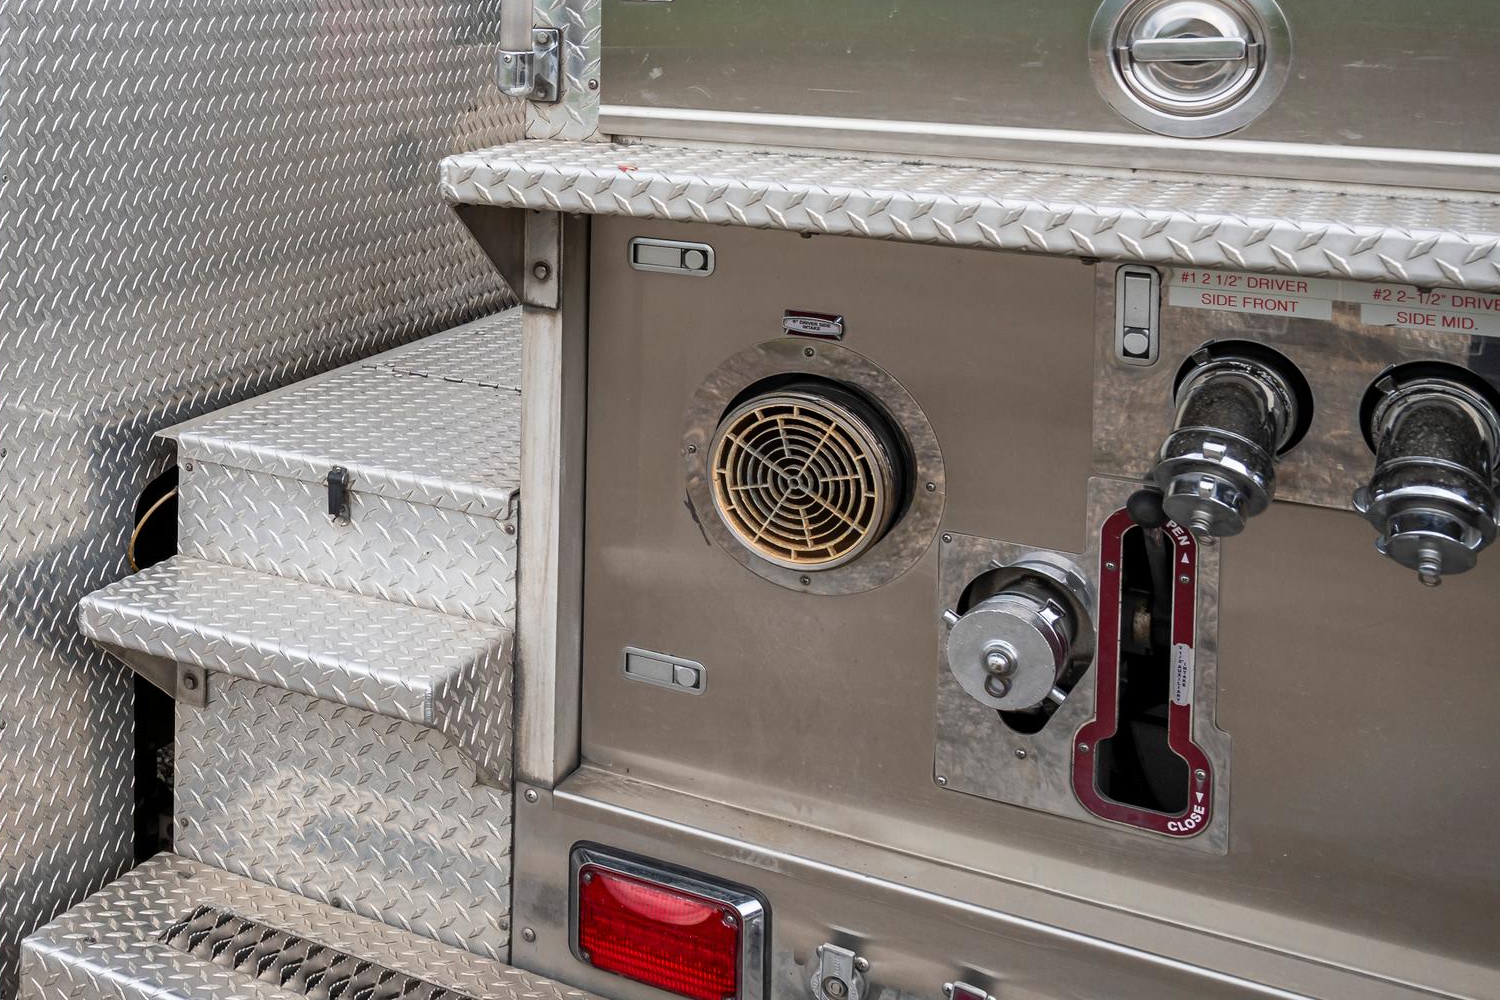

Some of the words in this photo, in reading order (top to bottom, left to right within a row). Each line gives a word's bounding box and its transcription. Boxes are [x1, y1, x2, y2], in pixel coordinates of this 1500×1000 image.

[1181, 271, 1196, 283] #1
[1202, 273, 1211, 285] 2
[1216, 274, 1243, 287] 1/2"
[1247, 277, 1308, 293] DRIVER
[1201, 293, 1238, 307] SIDE
[1243, 297, 1299, 313] FRONT
[1372, 288, 1392, 301] #2
[1396, 311, 1437, 326] SIDE
[1442, 315, 1478, 331] MID.
[1166, 520, 1190, 545] PEN
[1167, 804, 1205, 831] CLOSE
